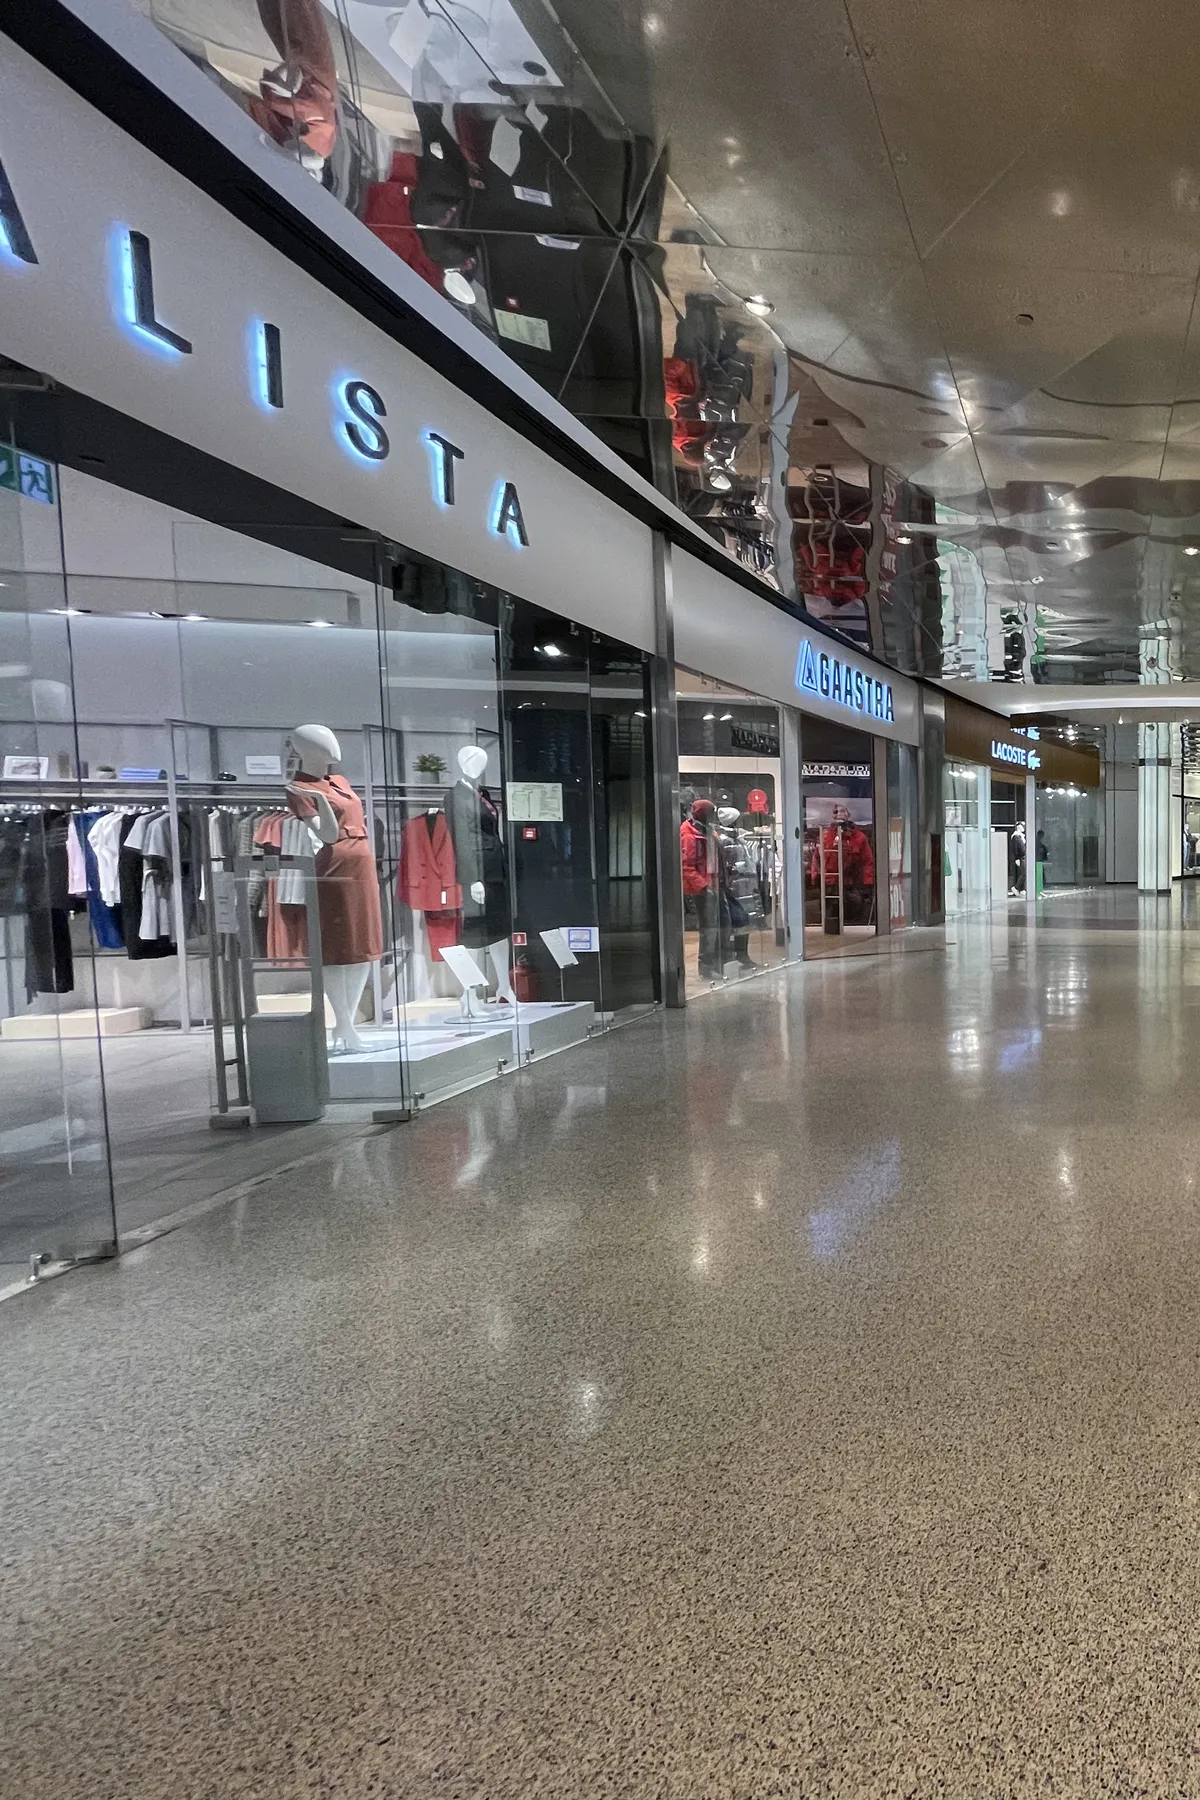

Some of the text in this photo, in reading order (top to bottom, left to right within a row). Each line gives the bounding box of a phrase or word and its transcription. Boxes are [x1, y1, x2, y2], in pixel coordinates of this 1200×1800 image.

[817, 652, 894, 722] GAASTRA
[991, 740, 1027, 765] LACOSTE
[801, 763, 870, 777] NAPAPIJRI
